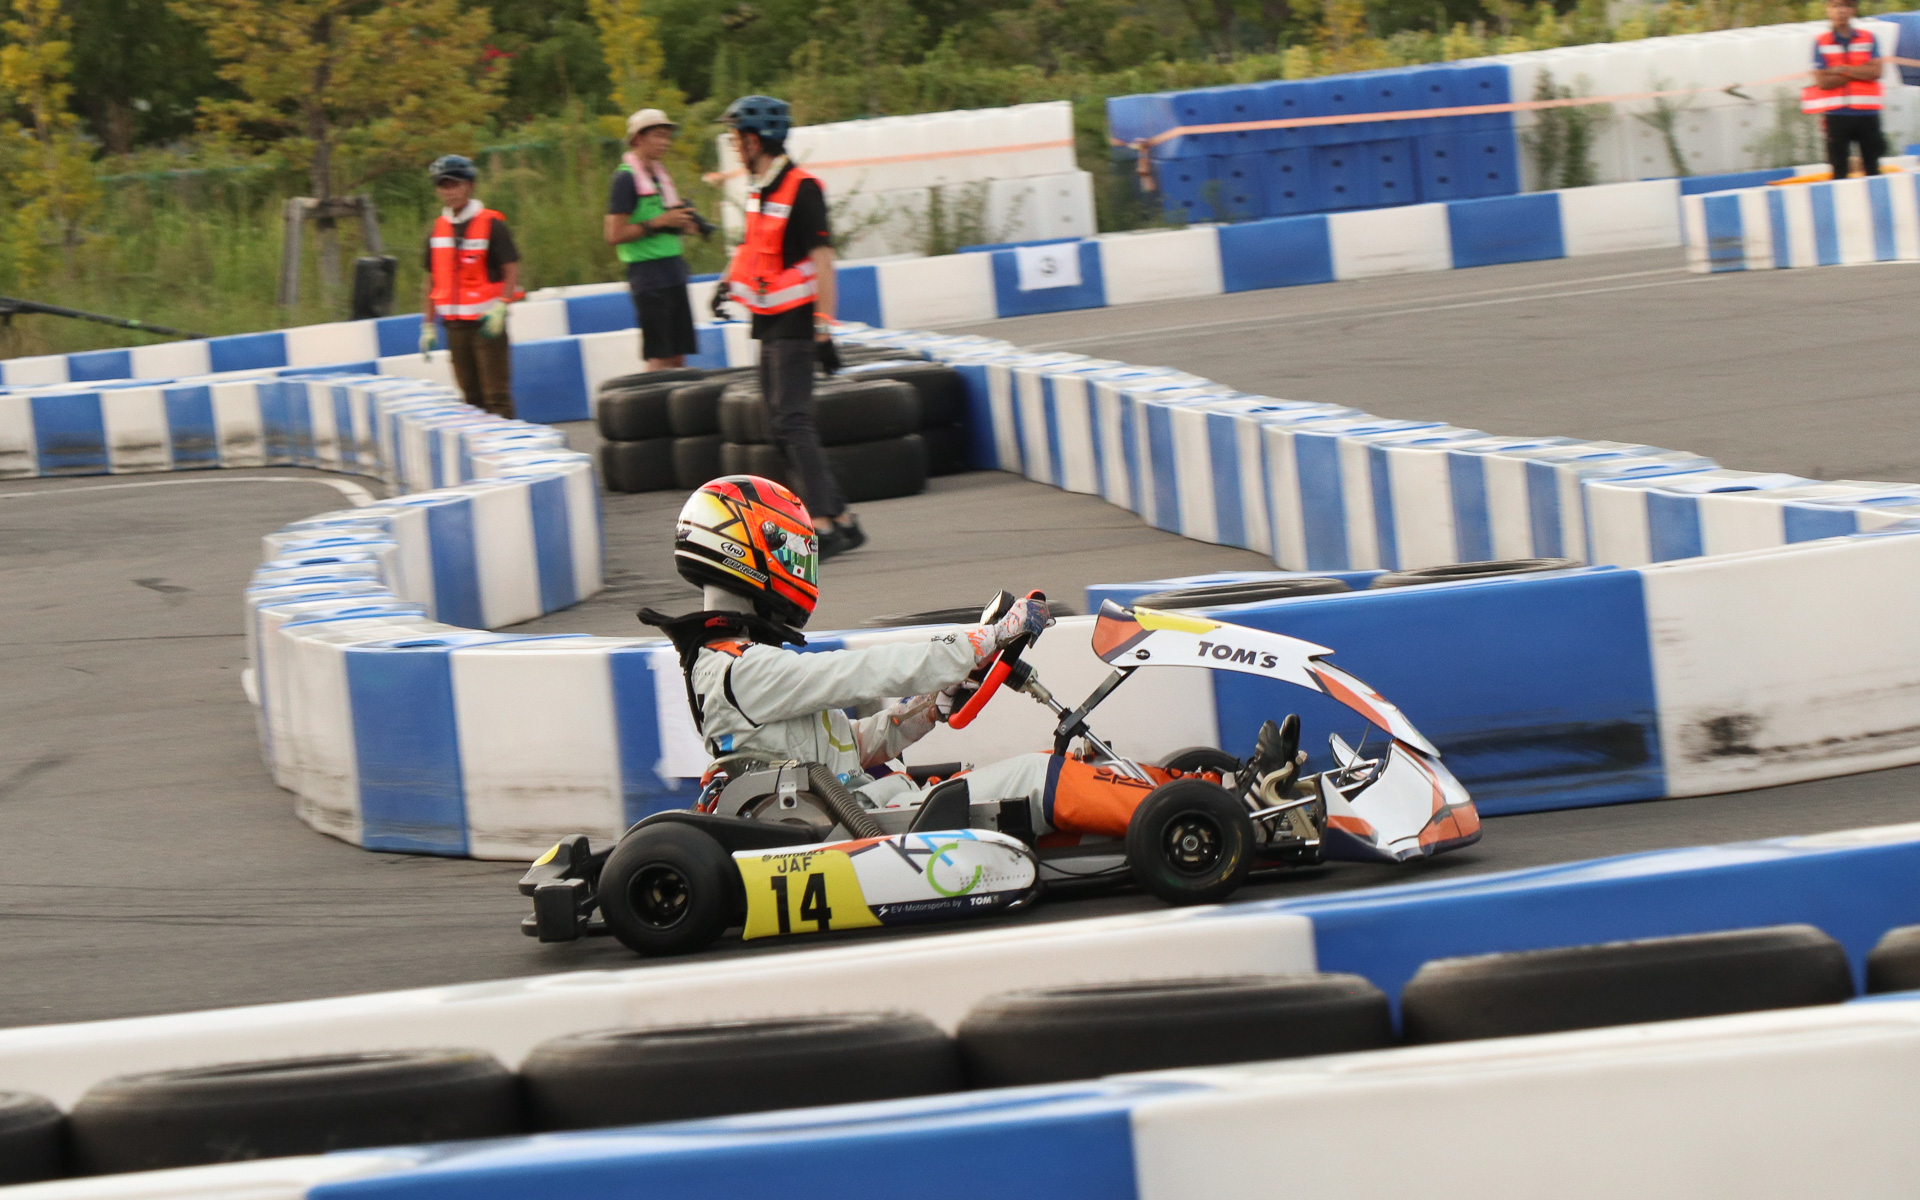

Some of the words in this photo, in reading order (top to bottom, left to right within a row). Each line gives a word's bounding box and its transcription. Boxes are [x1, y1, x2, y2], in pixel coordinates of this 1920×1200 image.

[723, 543, 743, 556] Arai
[1198, 641, 1278, 668] TOM'S
[777, 857, 812, 873] JAF
[770, 872, 832, 933] 14
[890, 901, 951, 914] EV-Motorsports
[952, 900, 962, 908] by
